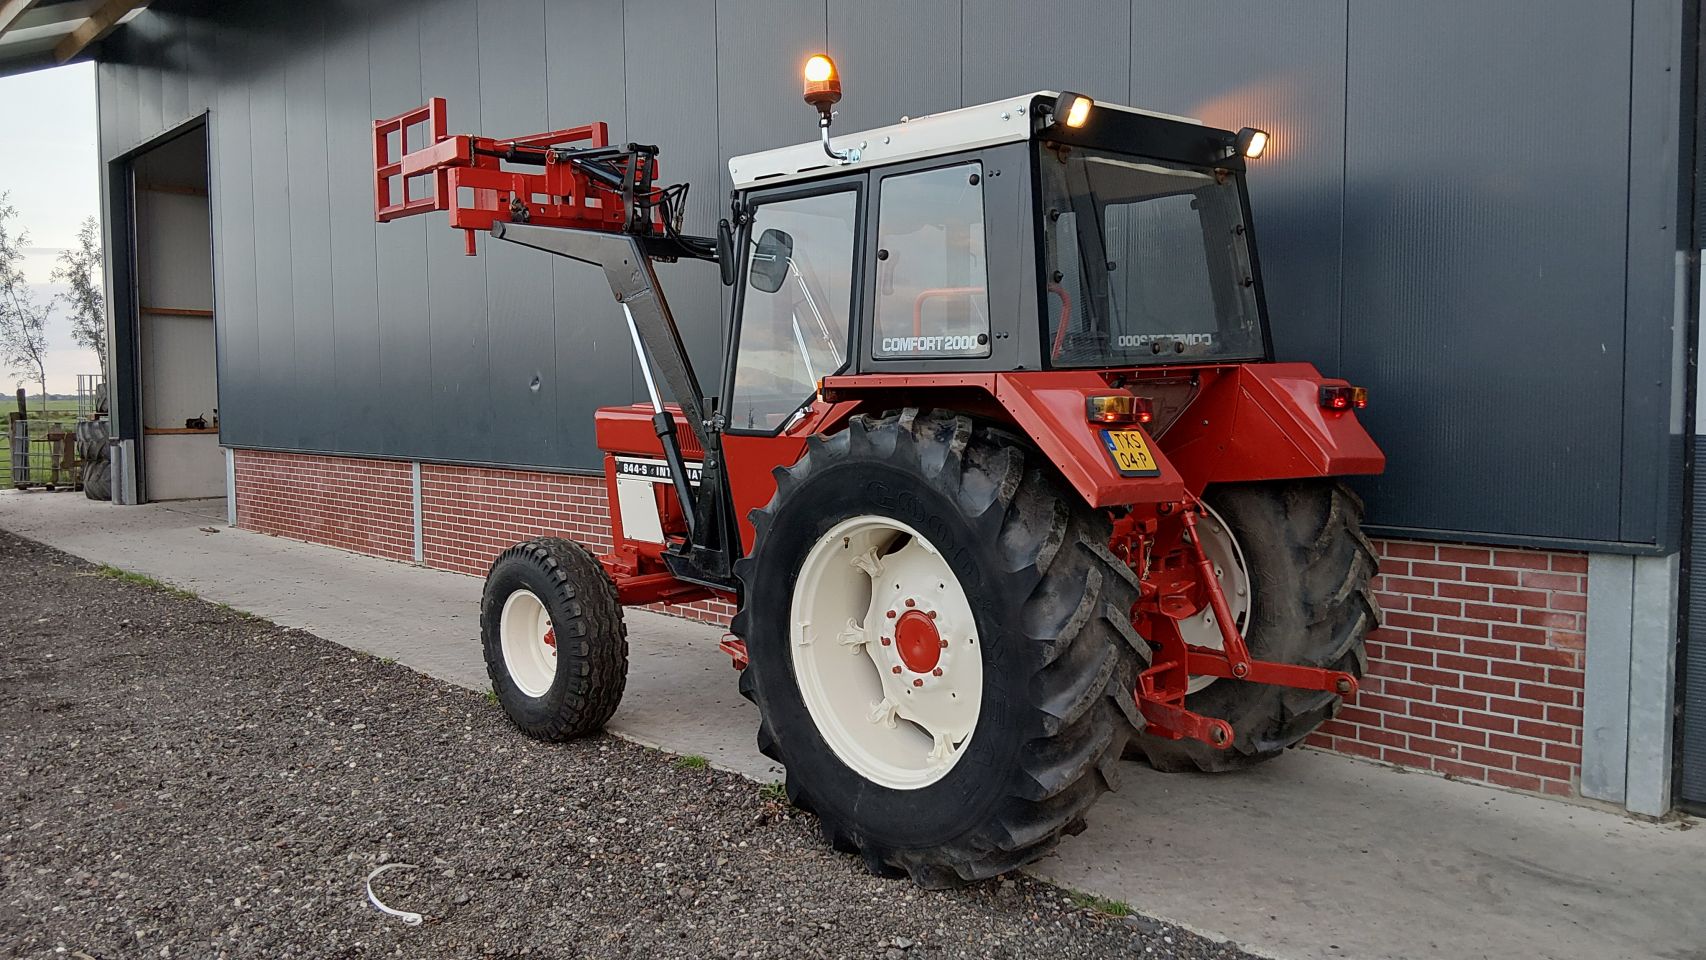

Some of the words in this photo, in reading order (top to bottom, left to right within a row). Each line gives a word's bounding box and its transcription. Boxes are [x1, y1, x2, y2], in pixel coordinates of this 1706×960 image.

[882, 336, 943, 351] COMFORT
[944, 335, 977, 350] 2000
[1114, 432, 1141, 449] TXS
[623, 463, 647, 474] 844-S
